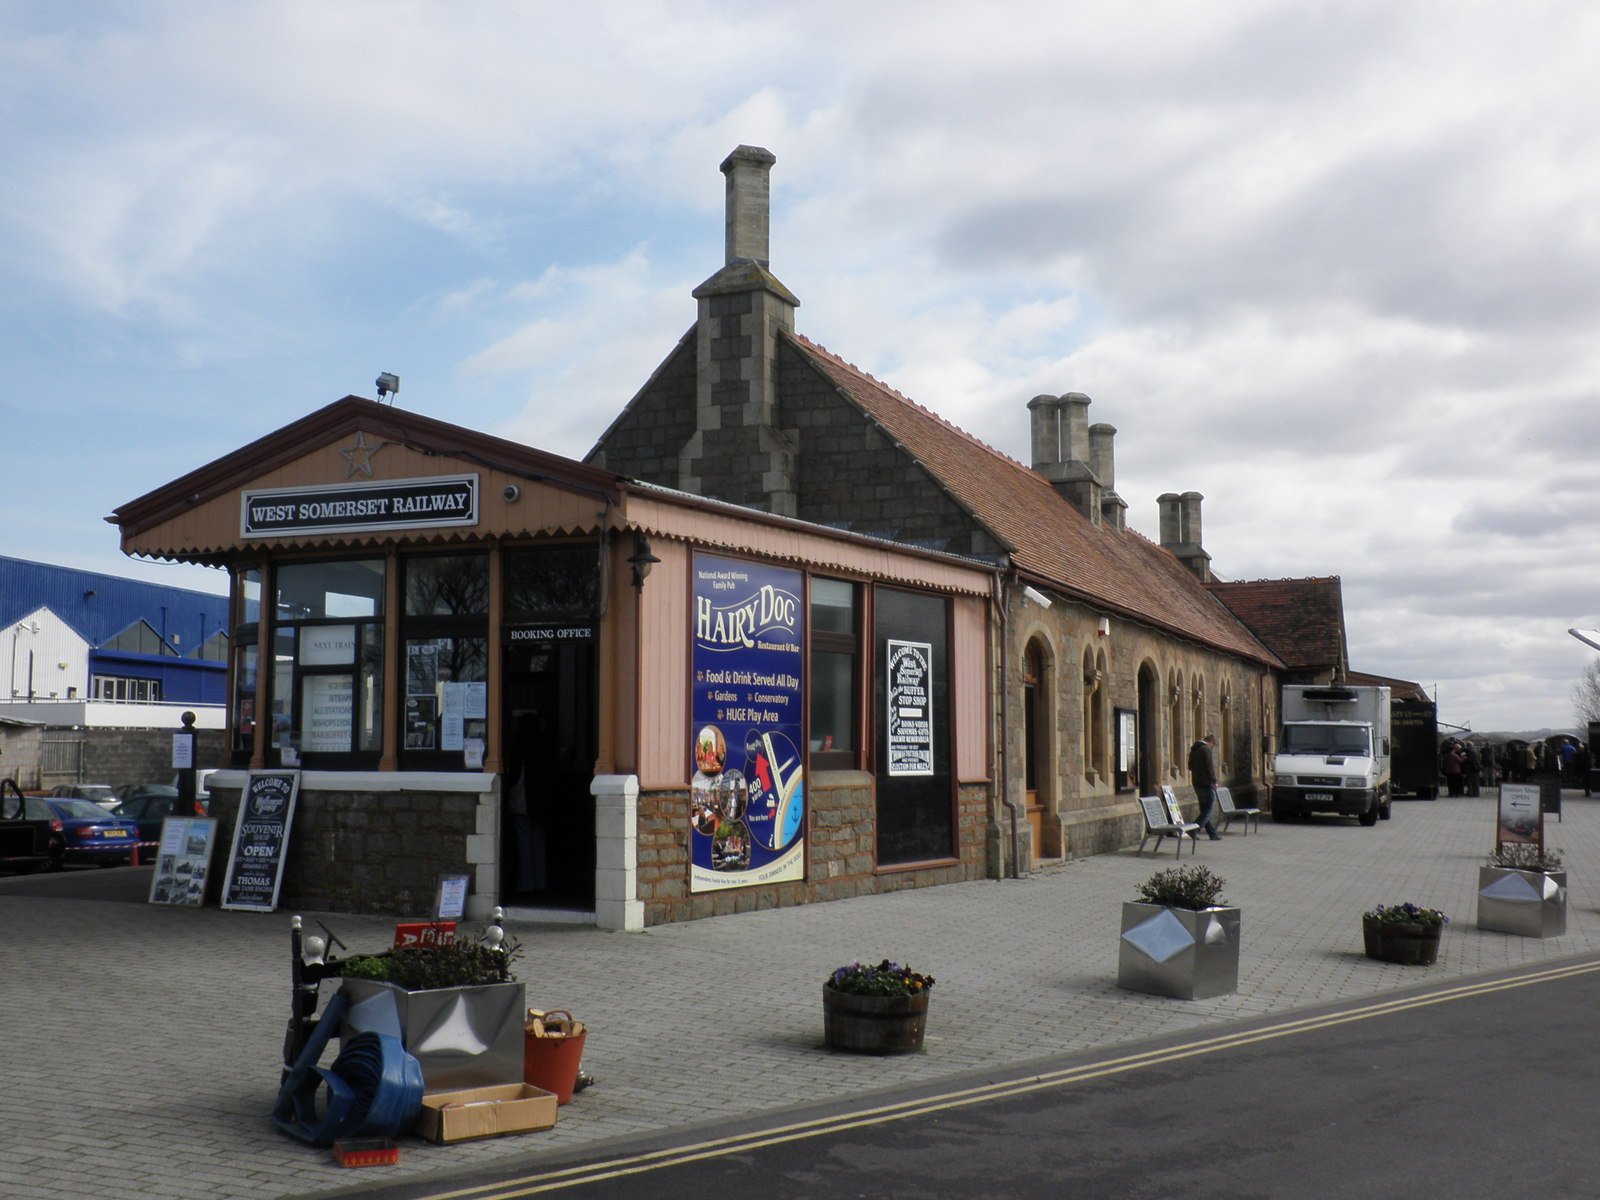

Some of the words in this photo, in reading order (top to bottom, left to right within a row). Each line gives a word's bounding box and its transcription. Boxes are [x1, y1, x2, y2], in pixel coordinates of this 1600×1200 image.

[252, 505, 295, 522] WEST
[300, 499, 388, 519] SOMERSET
[392, 493, 467, 513] RAILWAY
[699, 571, 717, 579] National
[717, 571, 731, 580] Award
[731, 572, 748, 582] Winning
[713, 581, 727, 591] Family
[727, 581, 736, 589] Pub
[697, 595, 759, 648] HAIRY
[760, 584, 795, 626] DOG
[511, 629, 554, 639] BOOKING
[557, 628, 591, 638] OFFICE
[757, 640, 785, 652] Restaurant
[786, 643, 791, 652] &
[791, 643, 799, 653] Bar
[890, 646, 913, 670] WELCOME
[913, 648, 920, 659] TO
[919, 654, 928, 672] THE
[706, 669, 724, 683] Food
[725, 671, 732, 684] &
[733, 671, 752, 685] Drink
[753, 672, 775, 686] Served
[776, 674, 786, 687] All
[786, 675, 799, 690] Day
[715, 690, 737, 701] Gardens
[755, 692, 789, 706] Conservatory
[904, 686, 925, 696] BUFFER
[898, 695, 913, 705] STOP
[913, 696, 927, 706] SHOP
[726, 708, 746, 721] HUGE
[747, 708, 761, 724] Play
[763, 709, 779, 722] Area
[252, 777, 283, 793] WELCOME
[281, 782, 290, 793] TO
[749, 778, 761, 794] 400
[751, 789, 763, 804] yards
[241, 825, 283, 838] SOUVENIR
[244, 846, 274, 856] OPEN
[237, 877, 271, 886] THOMAS
